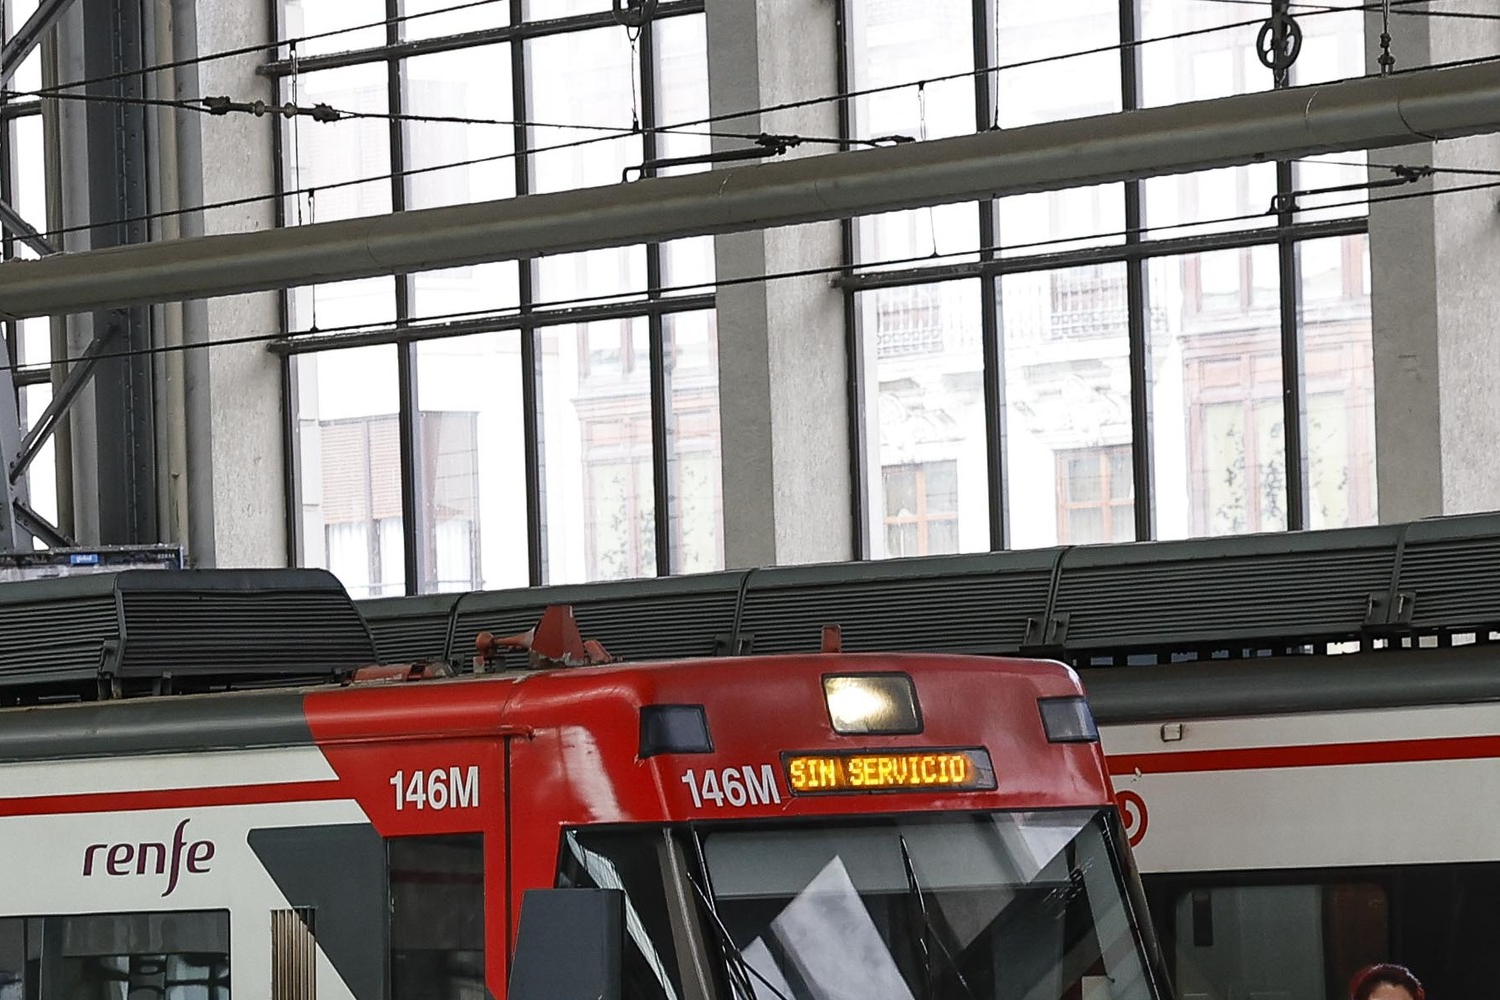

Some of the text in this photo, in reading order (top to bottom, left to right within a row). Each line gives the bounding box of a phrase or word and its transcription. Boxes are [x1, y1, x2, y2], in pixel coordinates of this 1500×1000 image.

[390, 766, 480, 810] 146M
[681, 764, 781, 808] 146M
[790, 755, 966, 788] SIN SERVICIO
[82, 818, 216, 897] renfe
